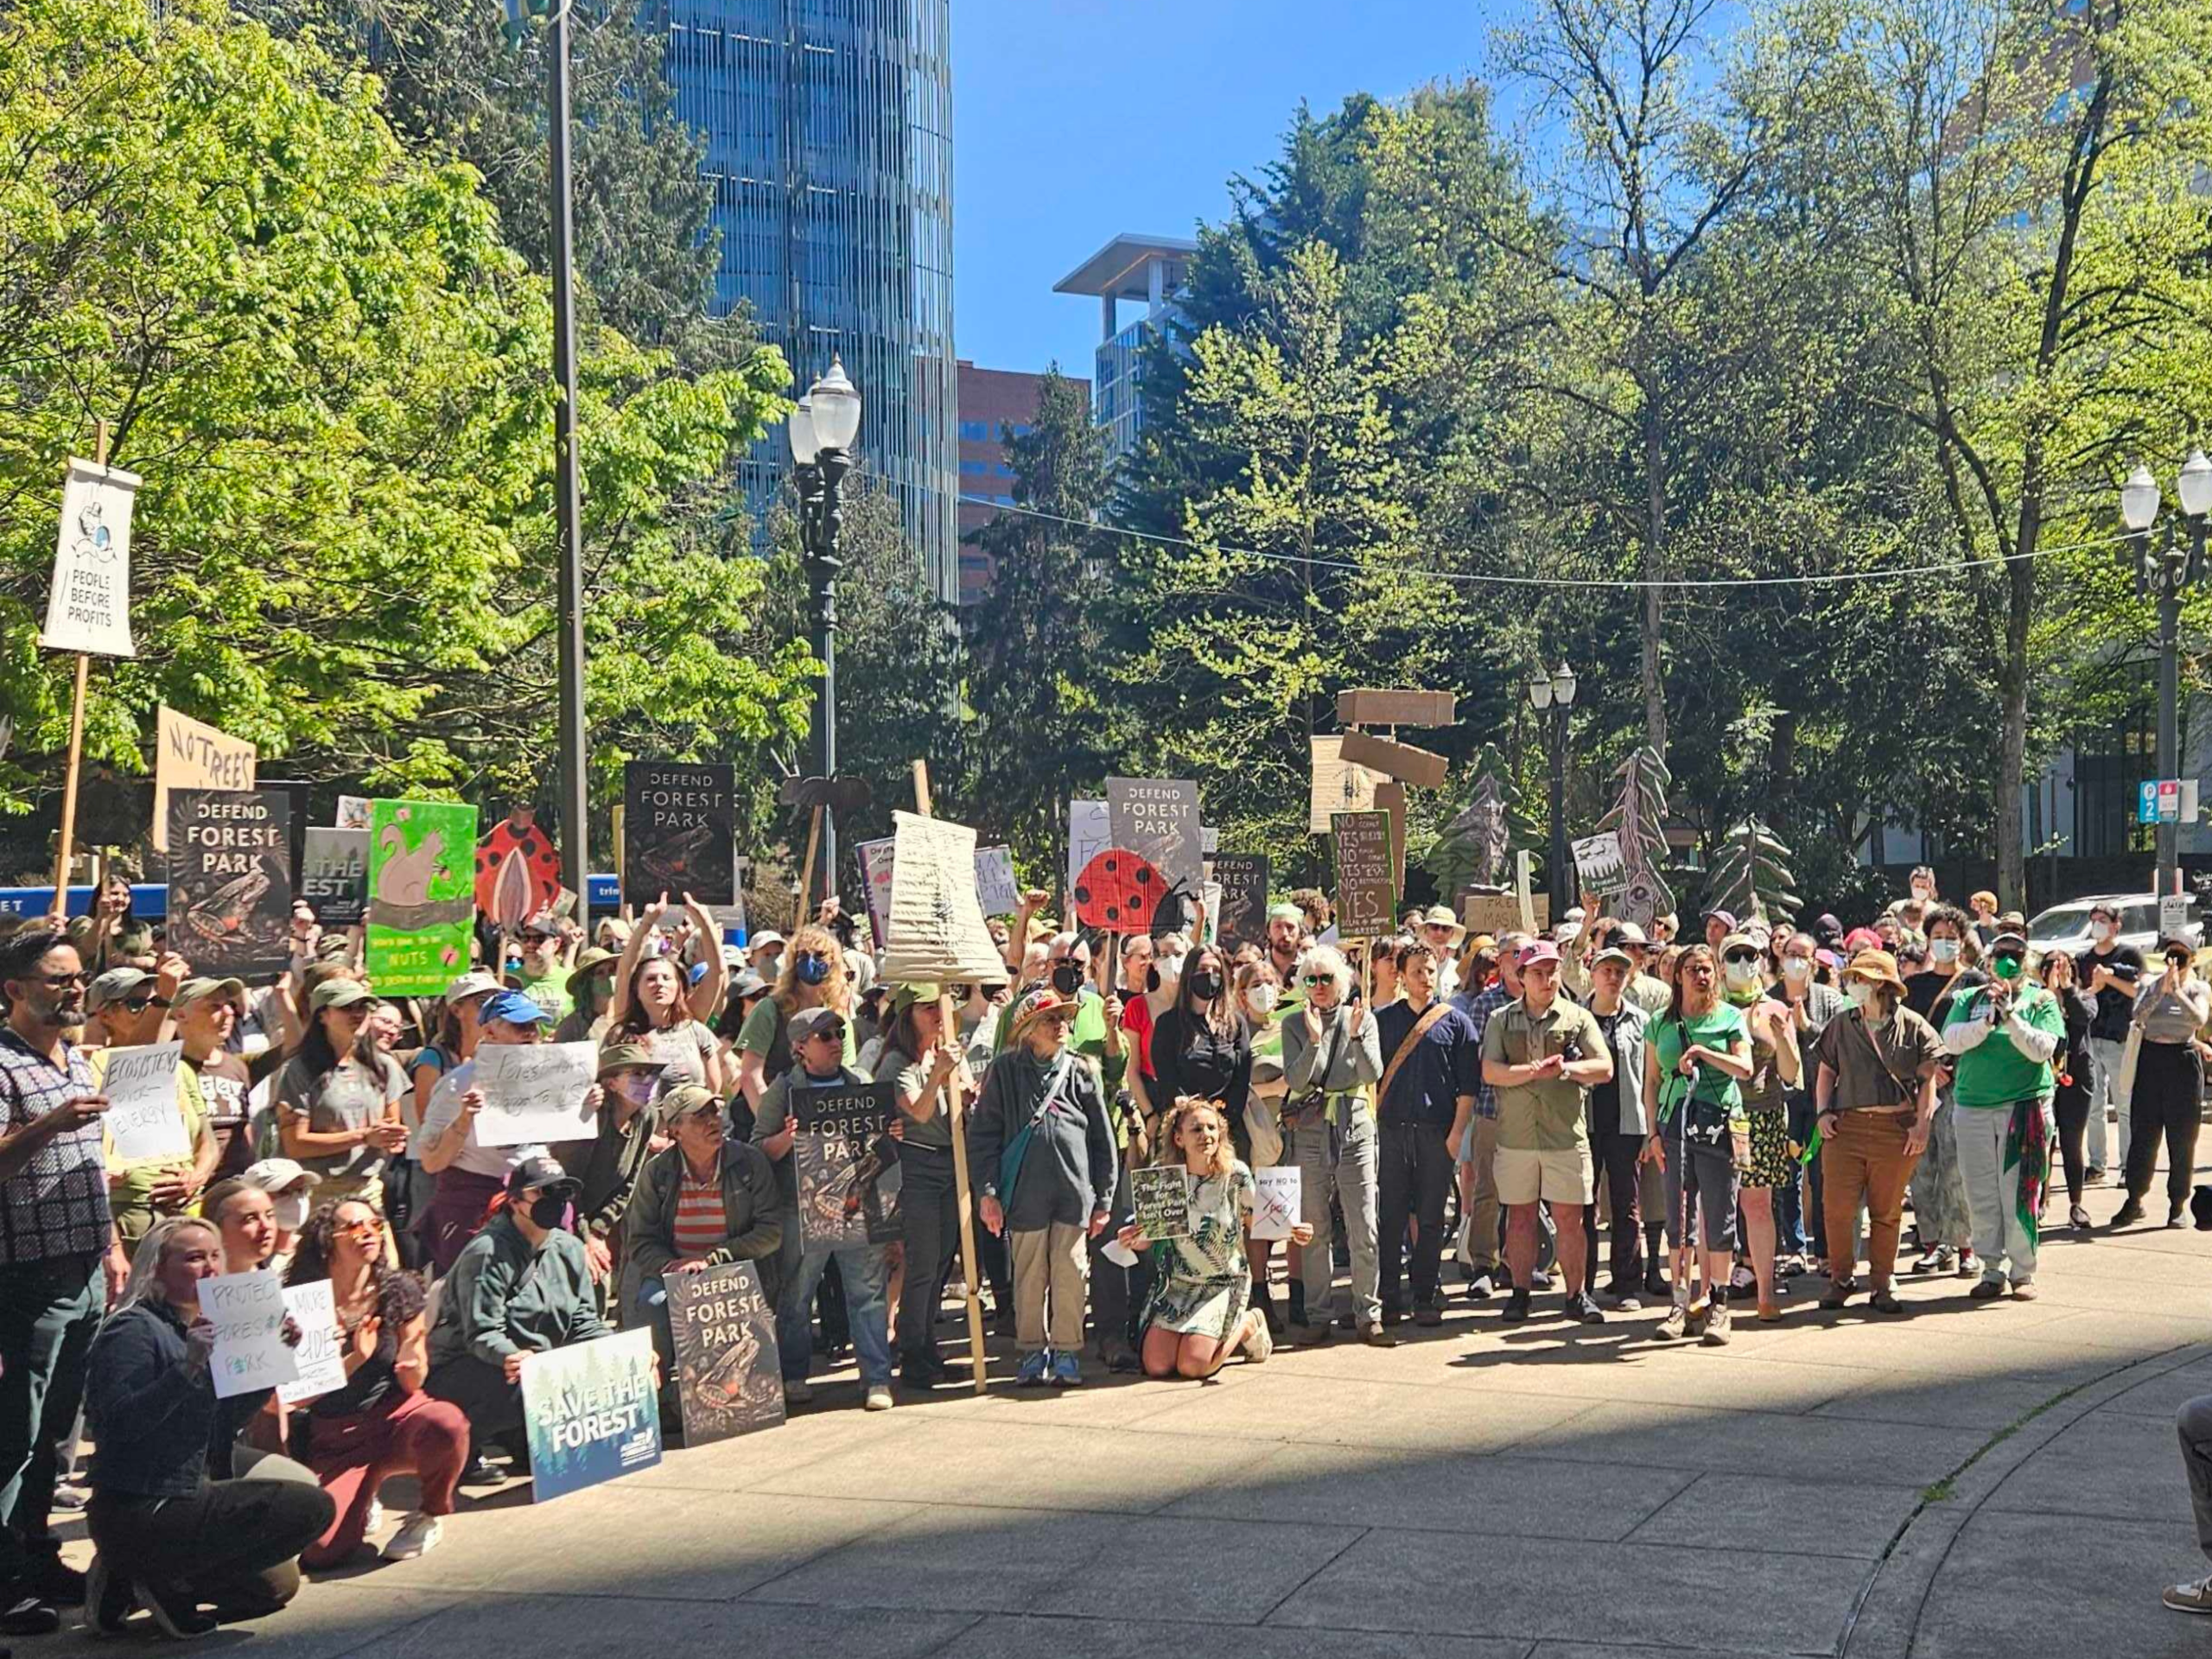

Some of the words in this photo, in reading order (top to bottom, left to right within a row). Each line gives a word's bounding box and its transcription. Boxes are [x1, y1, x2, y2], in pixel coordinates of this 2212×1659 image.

[73, 569, 110, 589] PEOPLE
[71, 588, 110, 608] BEFORE
[67, 607, 111, 627] PROFITS
[650, 773, 713, 787] DEFEND
[641, 791, 723, 808] FOREST
[1128, 788, 1180, 800] DEFEND
[197, 804, 268, 820] DEFEND
[1122, 803, 1190, 817] FOREST
[2145, 801, 2154, 817] 2
[654, 811, 709, 827] PARK
[1333, 815, 1354, 829] NO
[1135, 820, 1180, 835] PARK
[188, 826, 278, 847] FOREST
[1335, 830, 1359, 848] YES
[202, 853, 264, 873] PARK
[1337, 849, 1357, 863] NO
[315, 859, 363, 878] THE
[1338, 864, 1360, 877] YES
[1211, 874, 1259, 886] OREST
[1338, 876, 1357, 890] NO
[1221, 888, 1249, 899] ARK
[1338, 891, 1378, 920] YES
[1484, 912, 1522, 928] MASK
[389, 951, 428, 965] NUTS
[817, 1096, 875, 1113] DEFEND
[810, 1115, 887, 1137] FOREST
[823, 1138, 875, 1161] PARK
[1141, 1183, 1158, 1192] The
[1159, 1179, 1182, 1191] Fight
[1163, 1208, 1185, 1217] Over
[691, 1275, 750, 1299] DEFEND
[686, 1294, 760, 1324] FOREST
[702, 1320, 754, 1348] PARK
[538, 1387, 599, 1426] SAVE
[603, 1375, 648, 1406] THE
[551, 1402, 639, 1452] FOREST
